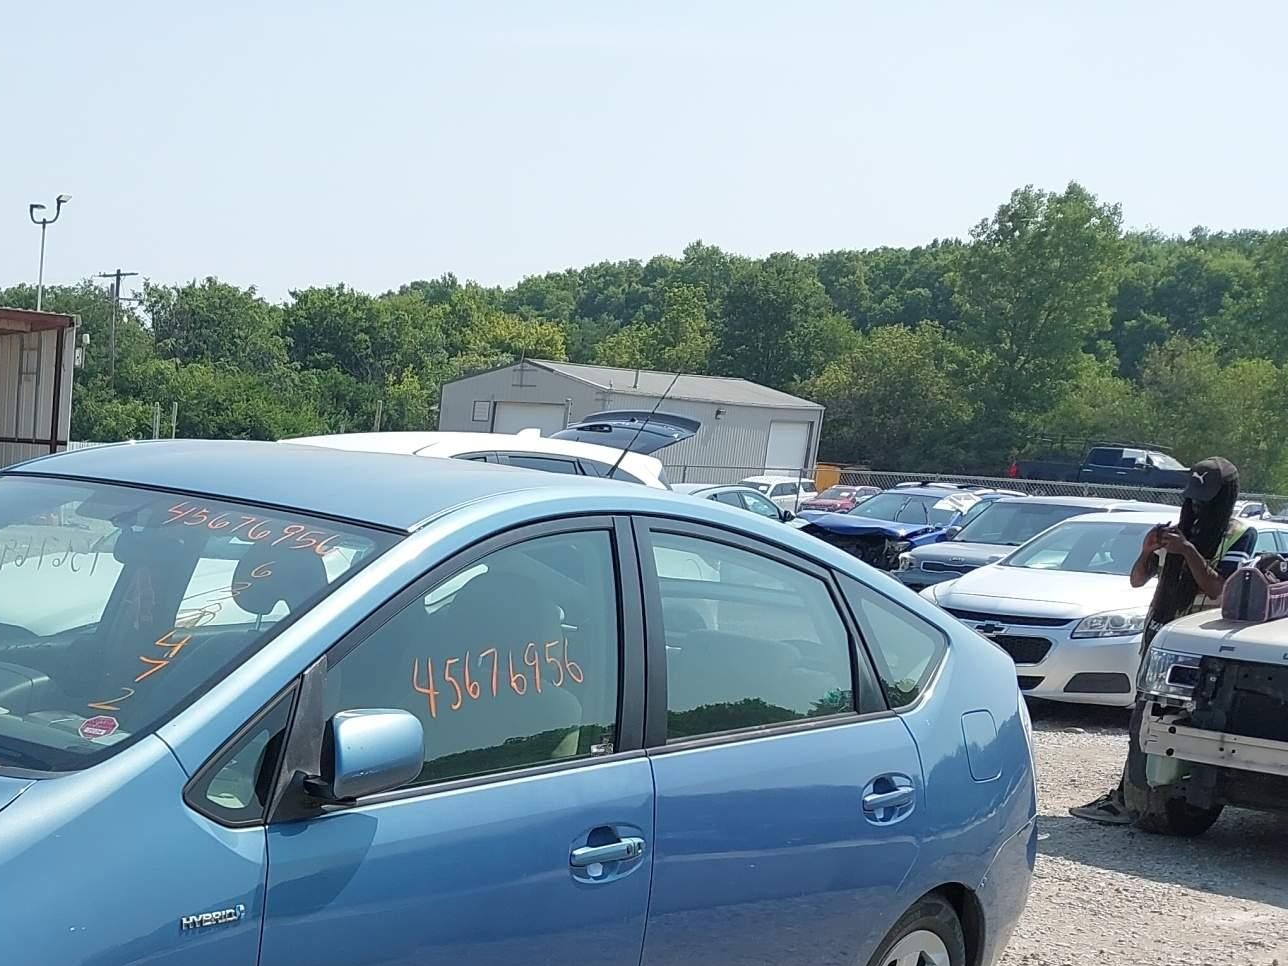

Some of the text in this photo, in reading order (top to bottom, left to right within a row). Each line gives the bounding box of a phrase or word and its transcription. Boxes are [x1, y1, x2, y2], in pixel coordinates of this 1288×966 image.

[162, 501, 341, 556] 45676956
[413, 637, 584, 719] 45676956
[181, 908, 238, 930] HYBRID
